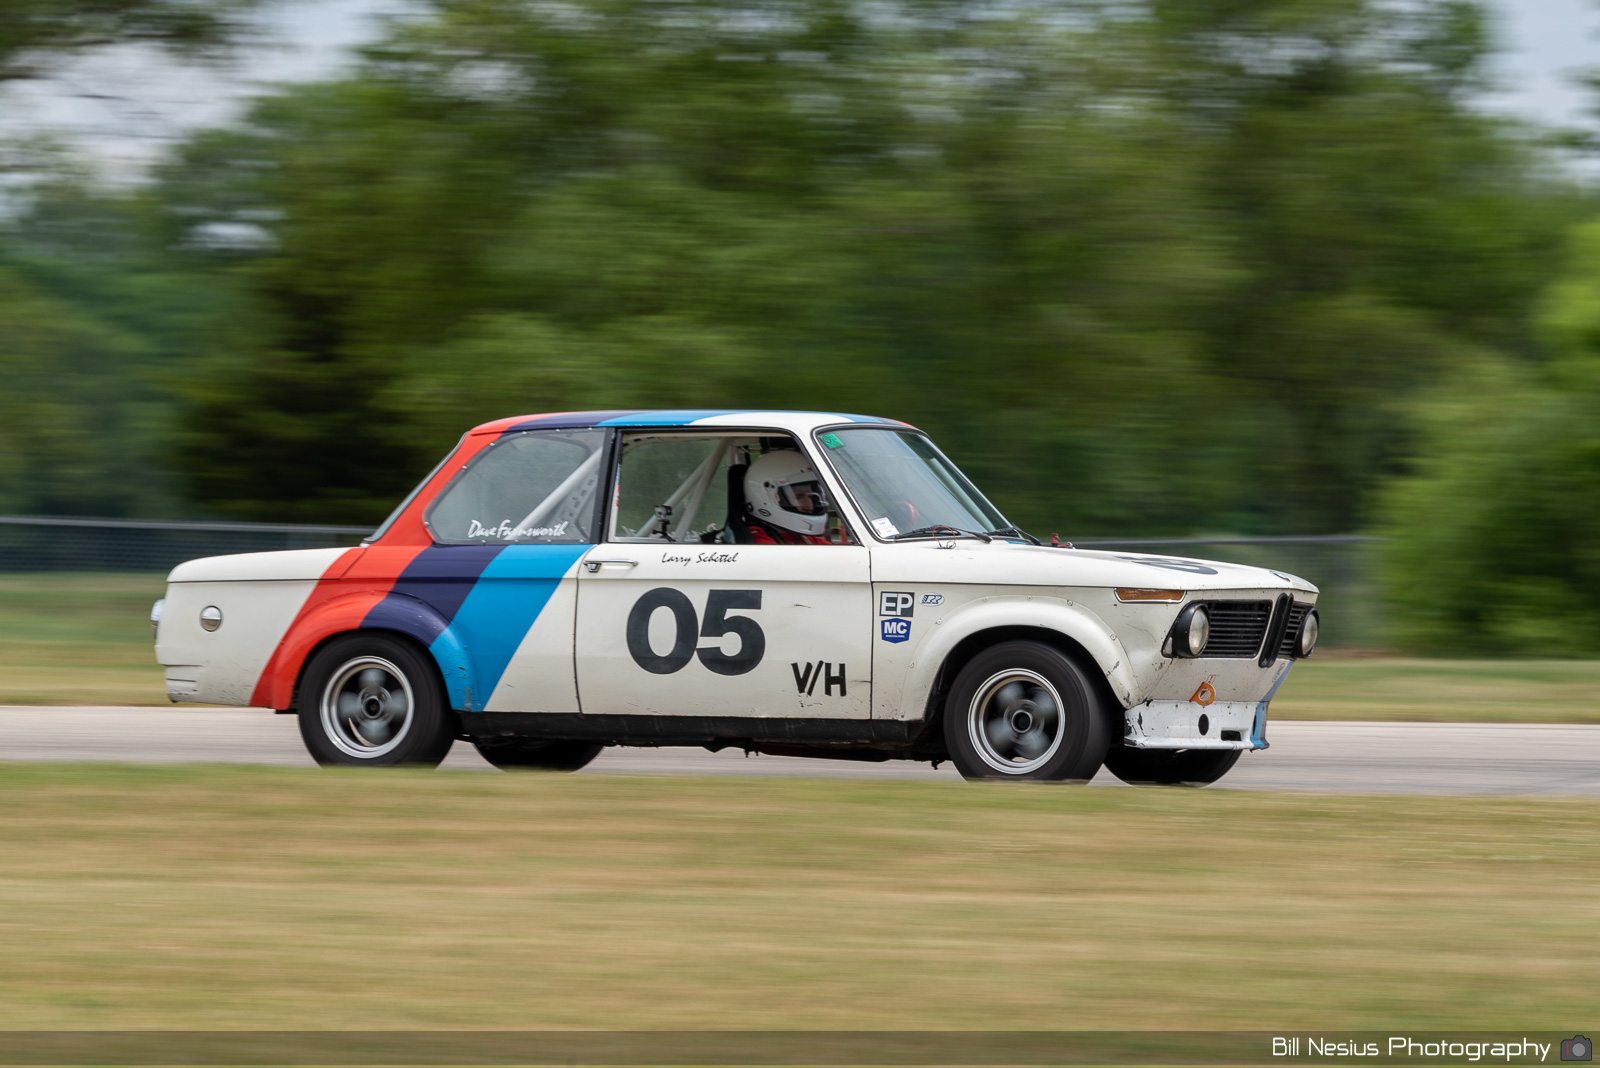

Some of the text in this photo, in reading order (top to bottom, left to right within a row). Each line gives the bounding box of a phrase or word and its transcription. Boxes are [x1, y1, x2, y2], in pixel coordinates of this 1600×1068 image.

[467, 519, 497, 538] Dave
[661, 552, 691, 567] Larry
[880, 592, 914, 616] EP
[626, 587, 766, 676] 05
[883, 621, 908, 635] MC
[791, 660, 847, 697] V/H
